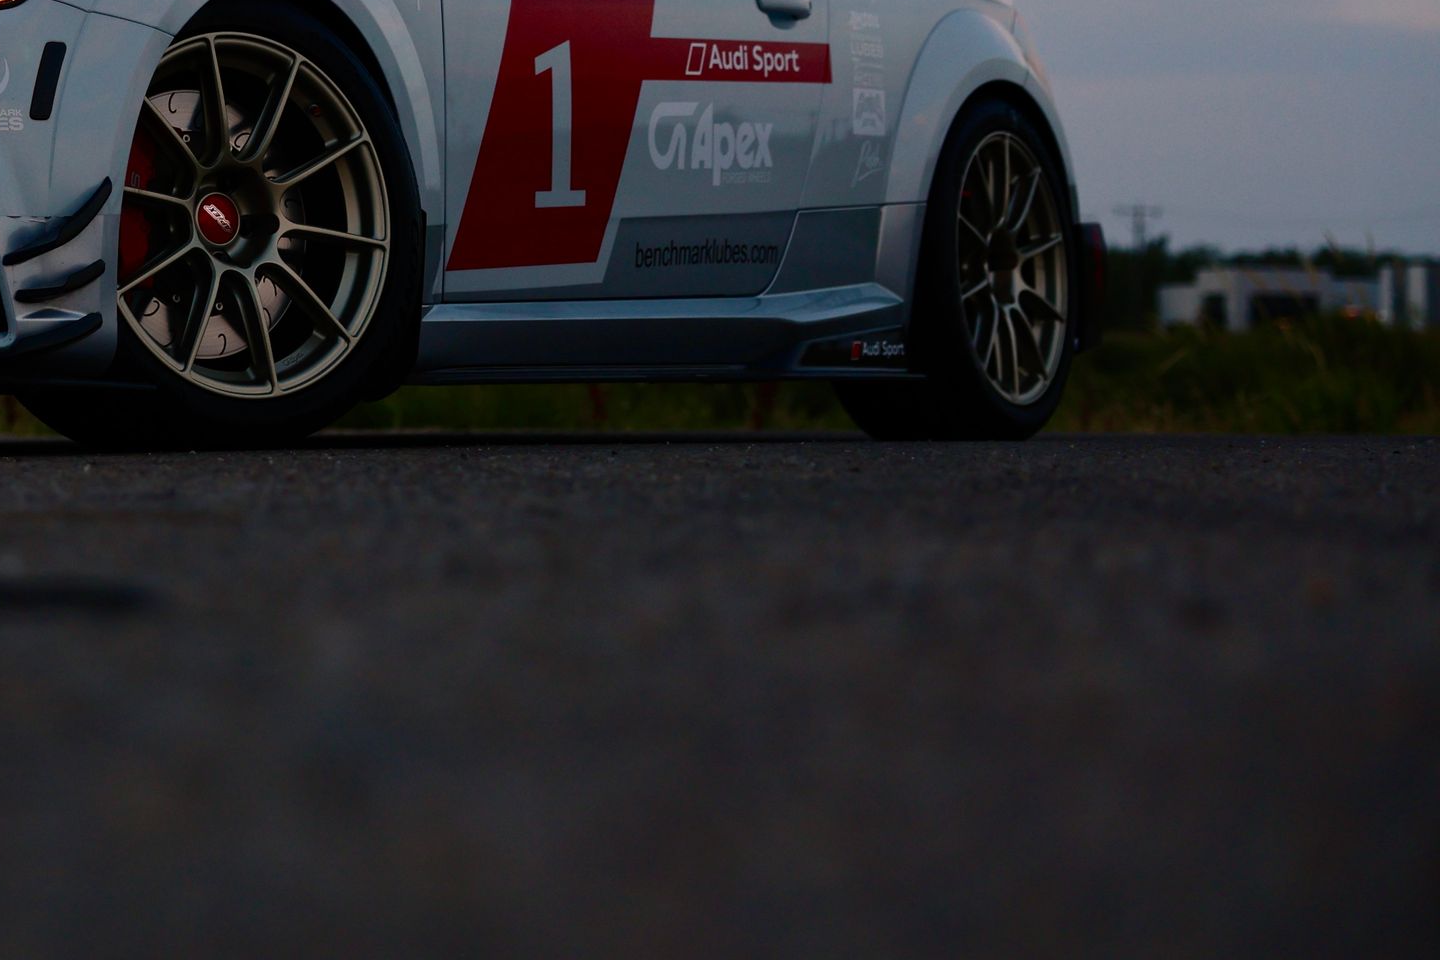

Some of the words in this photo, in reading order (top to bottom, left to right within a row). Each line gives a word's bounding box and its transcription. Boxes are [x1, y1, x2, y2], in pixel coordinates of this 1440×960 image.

[708, 43, 749, 71] Audi
[752, 45, 800, 78] Sport
[534, 40, 586, 208] 1
[635, 238, 778, 268] benchmarklubes.com
[863, 340, 880, 356] Audi
[882, 340, 905, 359] Sport
